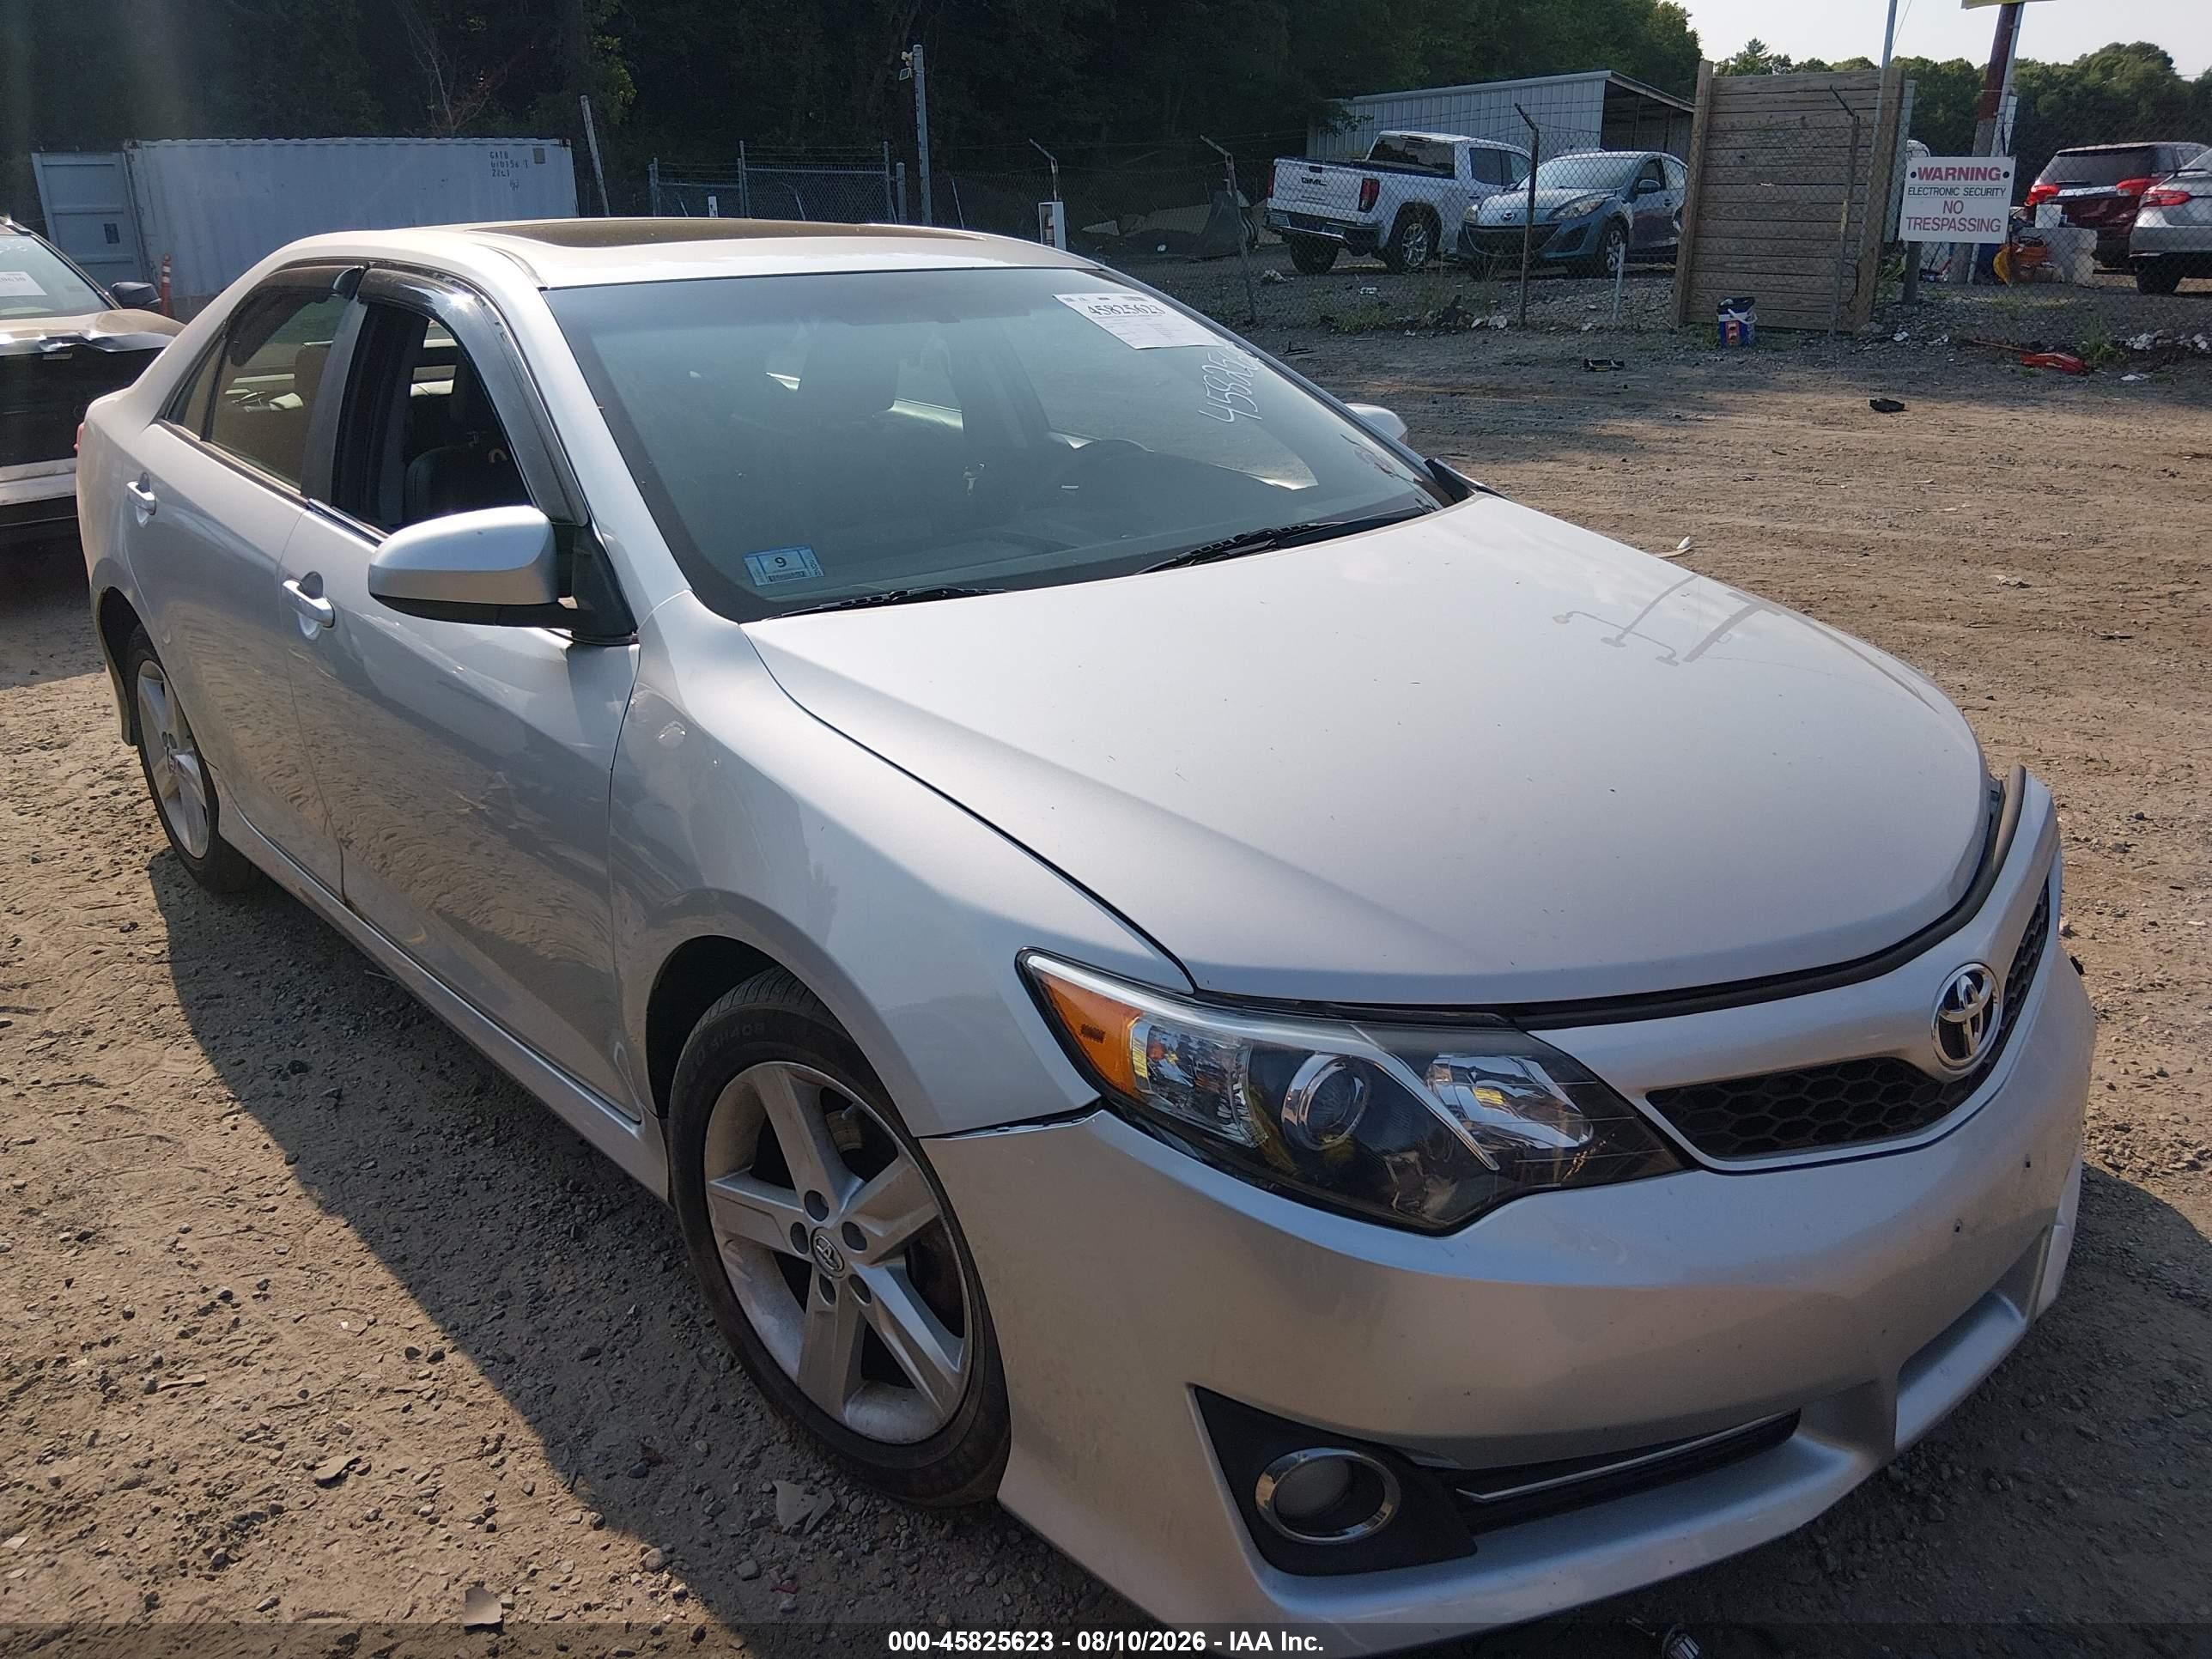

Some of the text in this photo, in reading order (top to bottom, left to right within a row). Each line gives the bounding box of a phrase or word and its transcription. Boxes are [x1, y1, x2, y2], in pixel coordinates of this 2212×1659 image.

[1917, 167, 2002, 181] WARNING
[1908, 186, 2007, 197] ELECTRONIC SECURITY
[1942, 200, 1964, 215] NO
[1905, 216, 2002, 233] TRESPASSING
[1087, 303, 1166, 315] 45825623
[775, 556, 787, 568] 9
